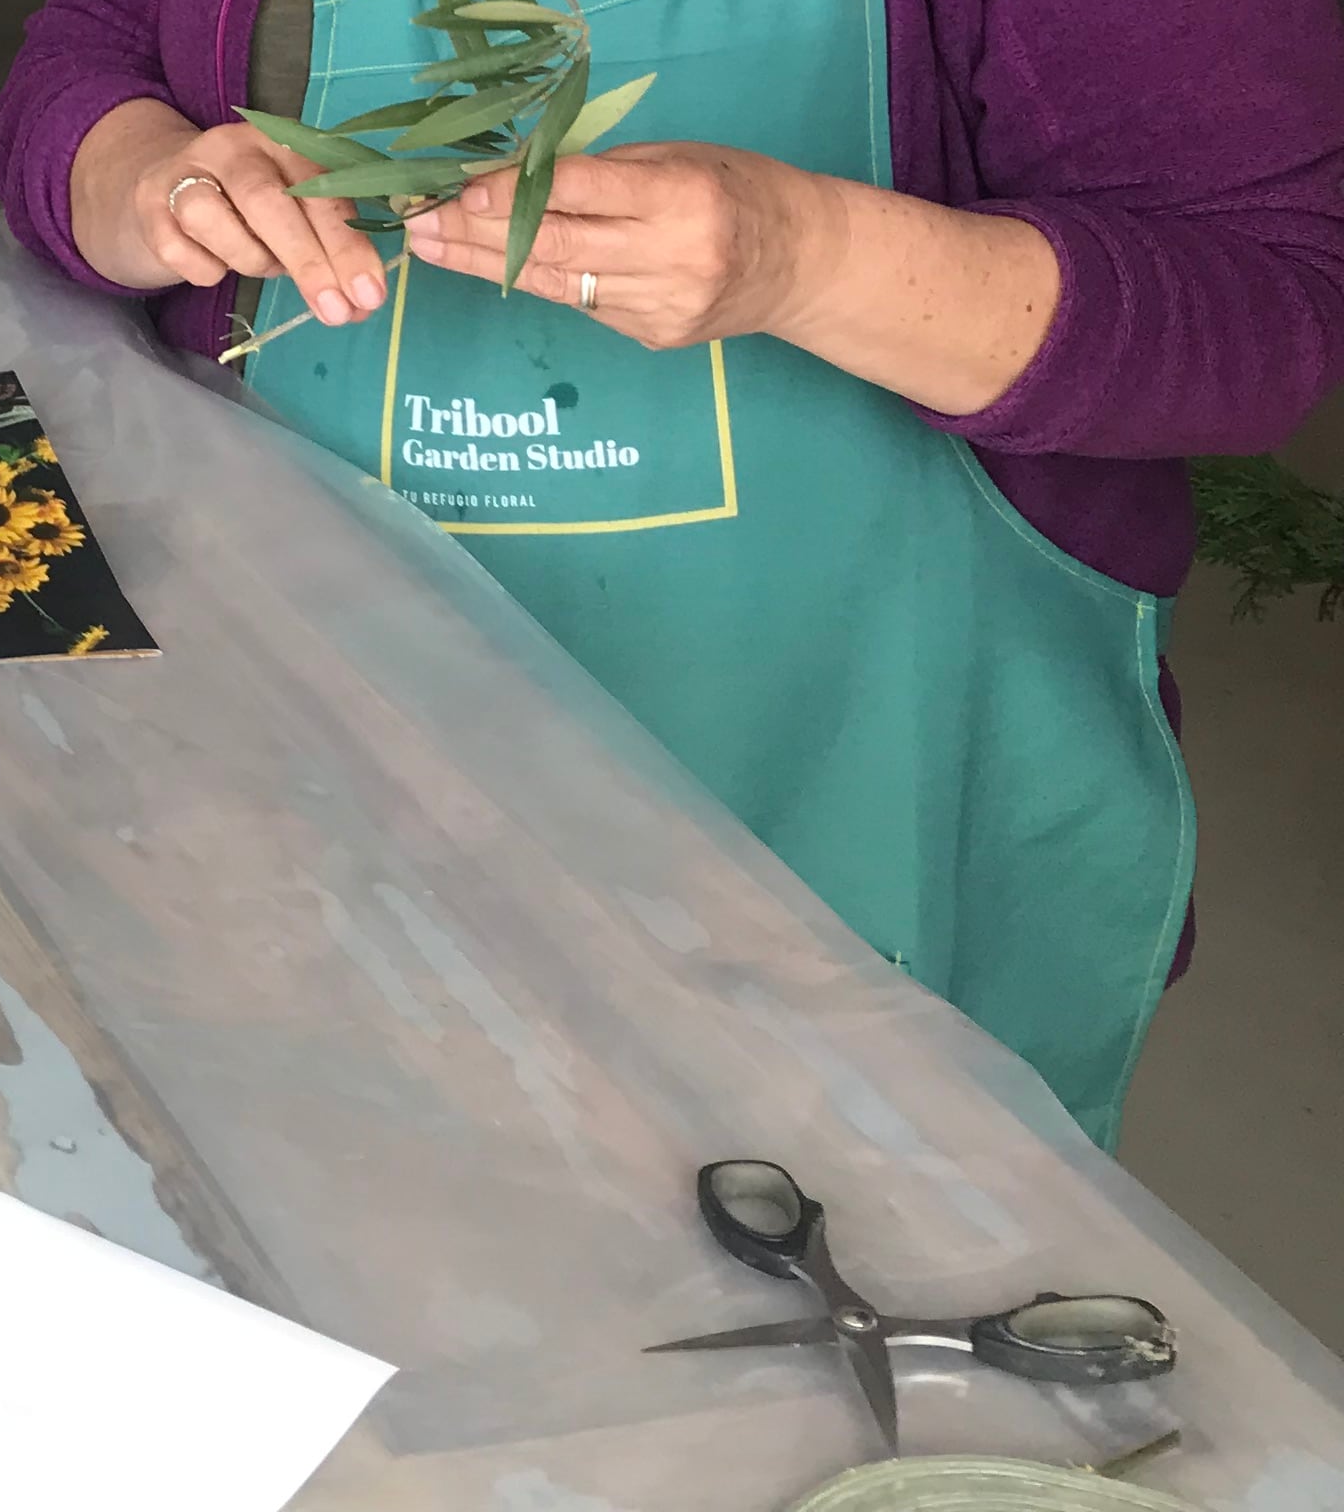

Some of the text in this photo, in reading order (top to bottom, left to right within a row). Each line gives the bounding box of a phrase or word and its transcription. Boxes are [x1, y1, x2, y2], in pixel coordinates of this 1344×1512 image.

[404, 393, 561, 438] Tribool
[402, 438, 640, 472] Garden Studio
[423, 491, 479, 508] REFUGIO
[484, 493, 537, 509] FLORAL
